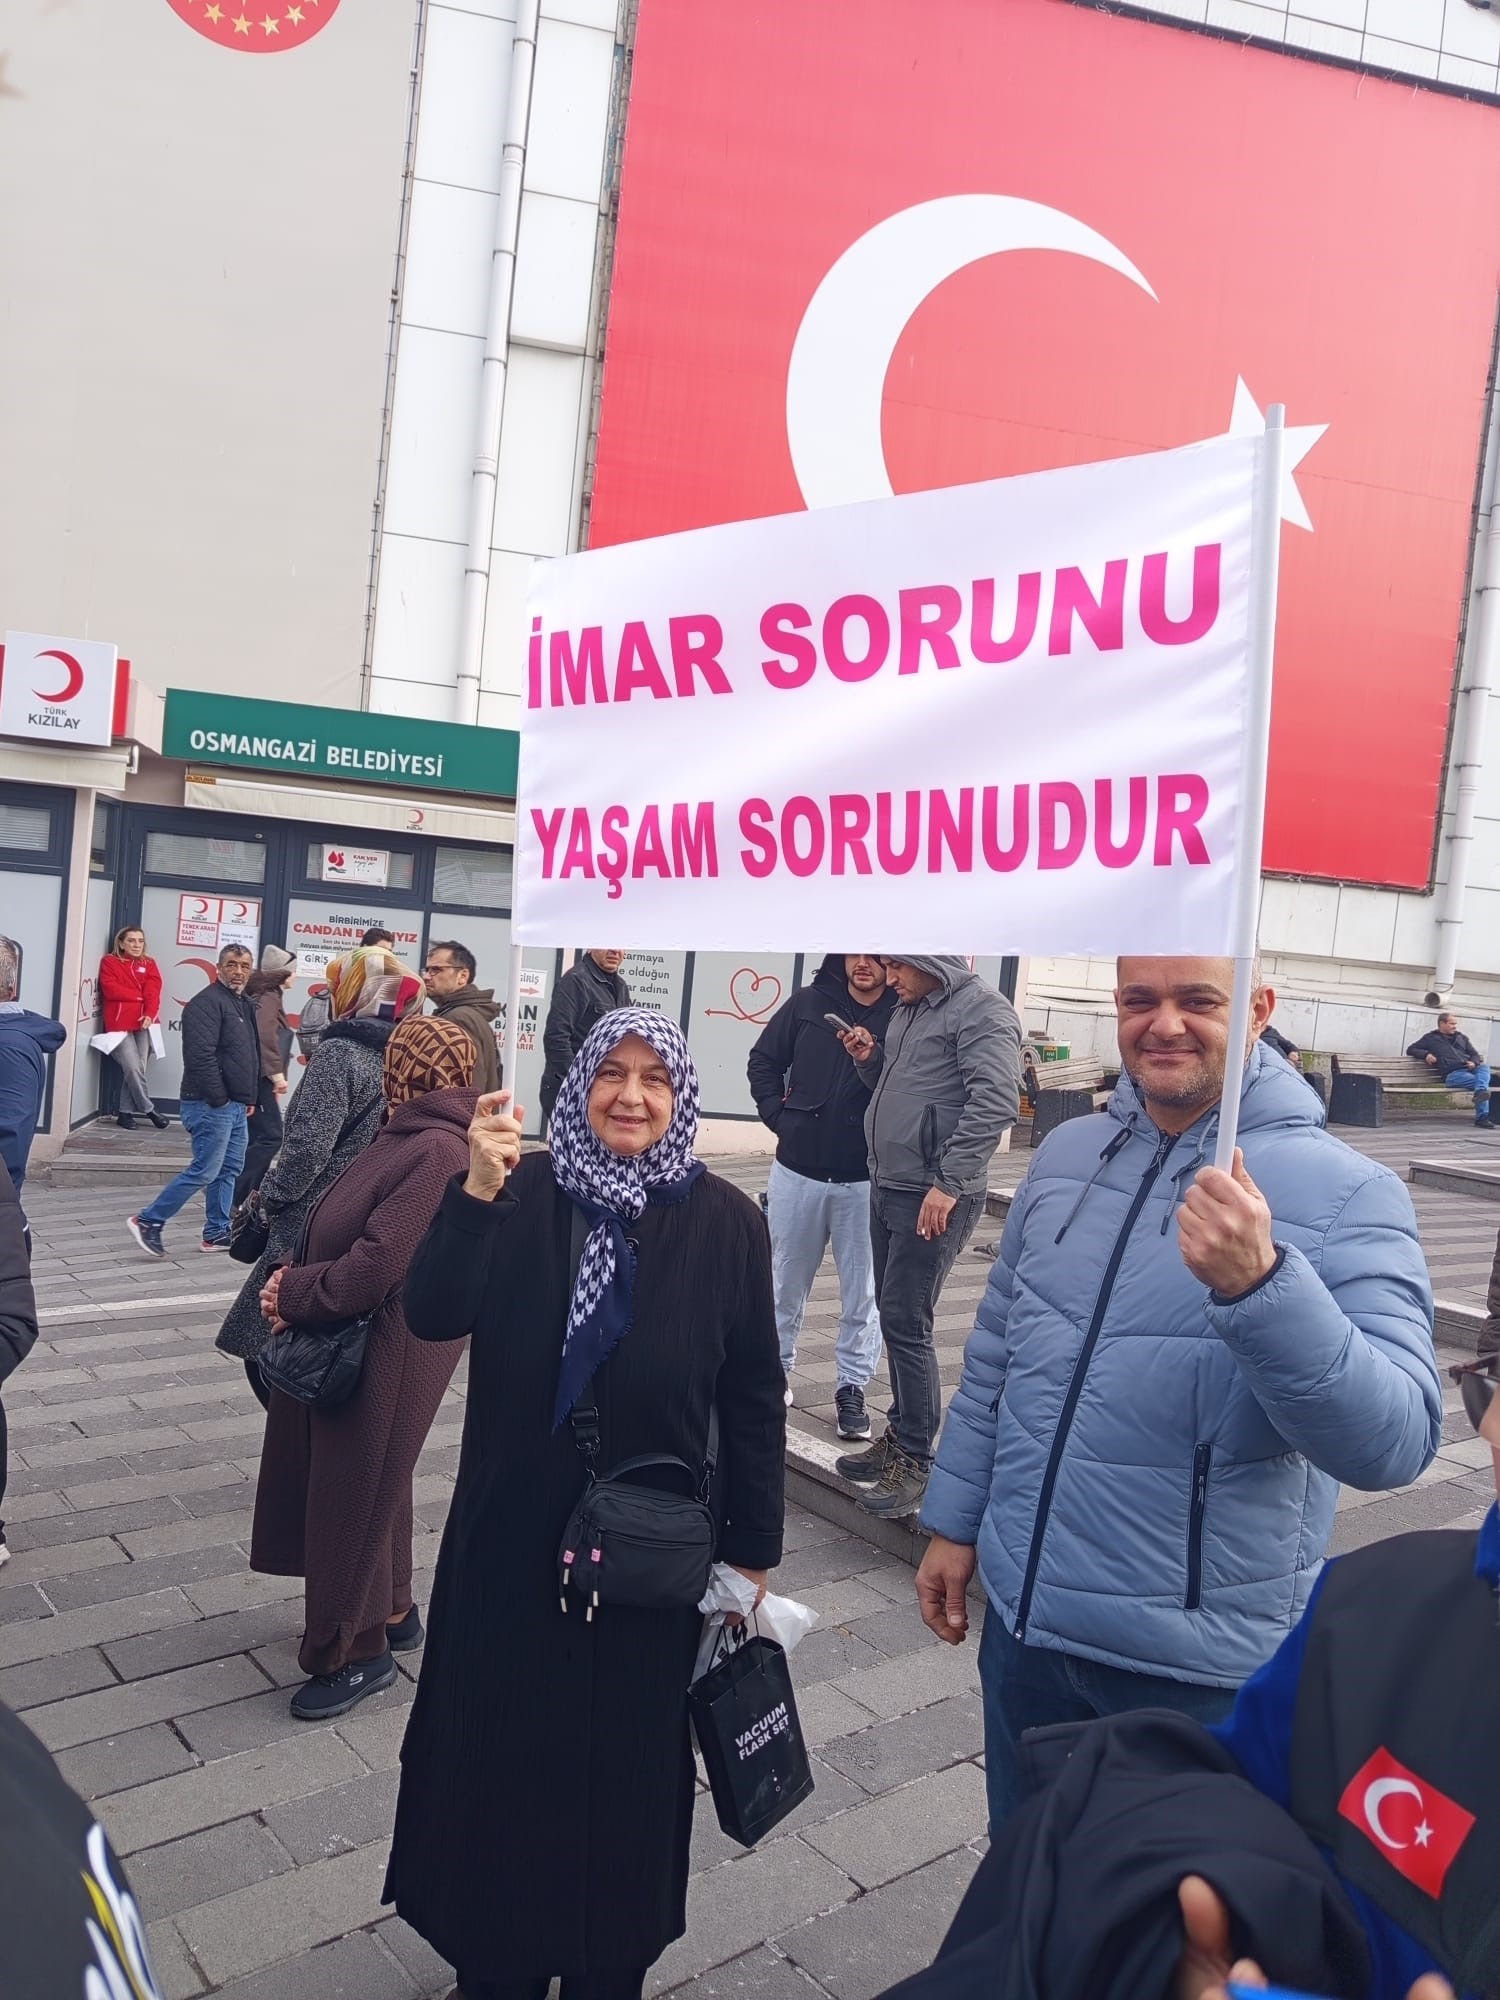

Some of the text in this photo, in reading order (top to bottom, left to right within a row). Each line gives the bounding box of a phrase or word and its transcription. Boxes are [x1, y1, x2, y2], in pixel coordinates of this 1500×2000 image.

[527, 543, 1222, 710] İMAR SORUNU
[44, 706, 67, 716] TÜRK
[28, 713, 80, 729] KIZILAY
[190, 729, 443, 778] OSMANGAZİ BELEDİYESİ
[530, 773, 1212, 899] YAŞAM SORUNUDUR
[329, 914, 385, 927] BİRBİRİMİZE
[293, 923, 352, 938] CANDAN
[304, 953, 329, 965] GİRİŞ
[628, 965, 670, 981] olduğun
[640, 982, 669, 994] adına
[629, 998, 661, 1010] Varsın
[735, 1701, 786, 1747] VACUUM
[739, 1714, 789, 1760] FLASK SET
